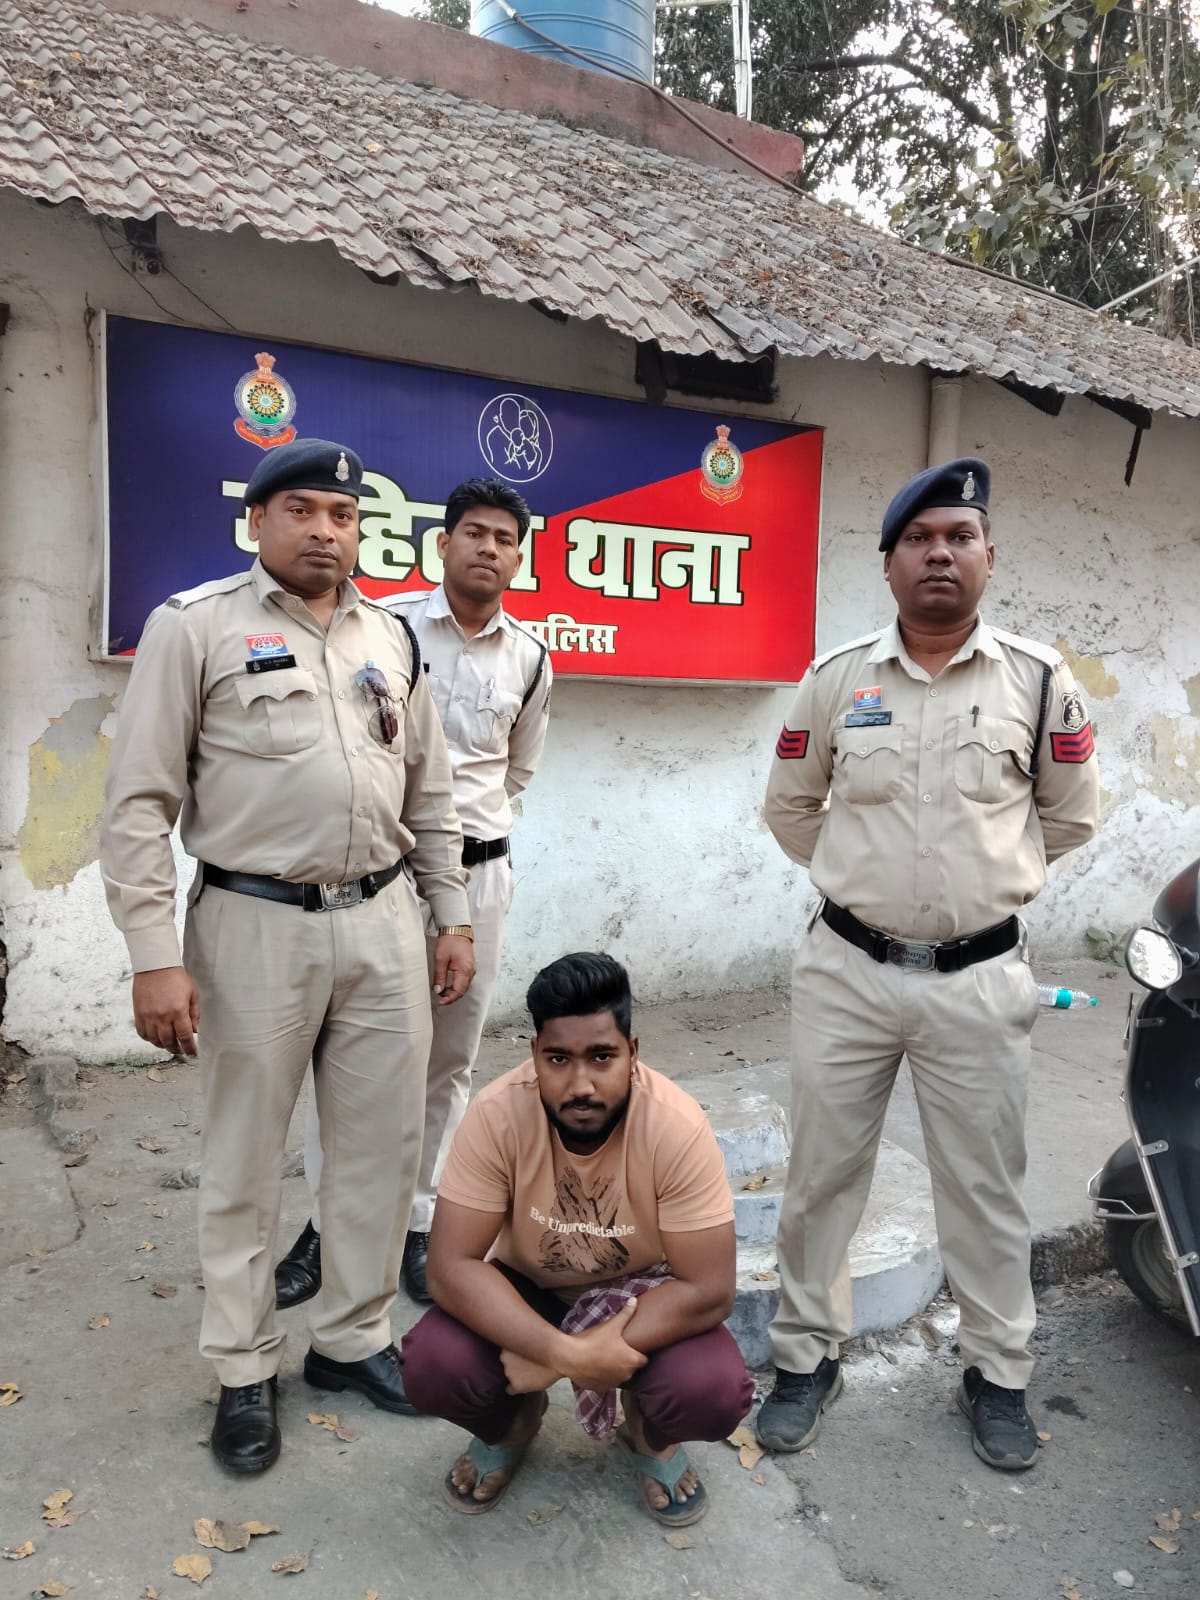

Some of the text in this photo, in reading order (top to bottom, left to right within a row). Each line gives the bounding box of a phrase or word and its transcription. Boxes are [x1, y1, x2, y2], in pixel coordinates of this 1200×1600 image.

[566, 516, 752, 606] थाना
[529, 1206, 636, 1238] Be Unpredictable
